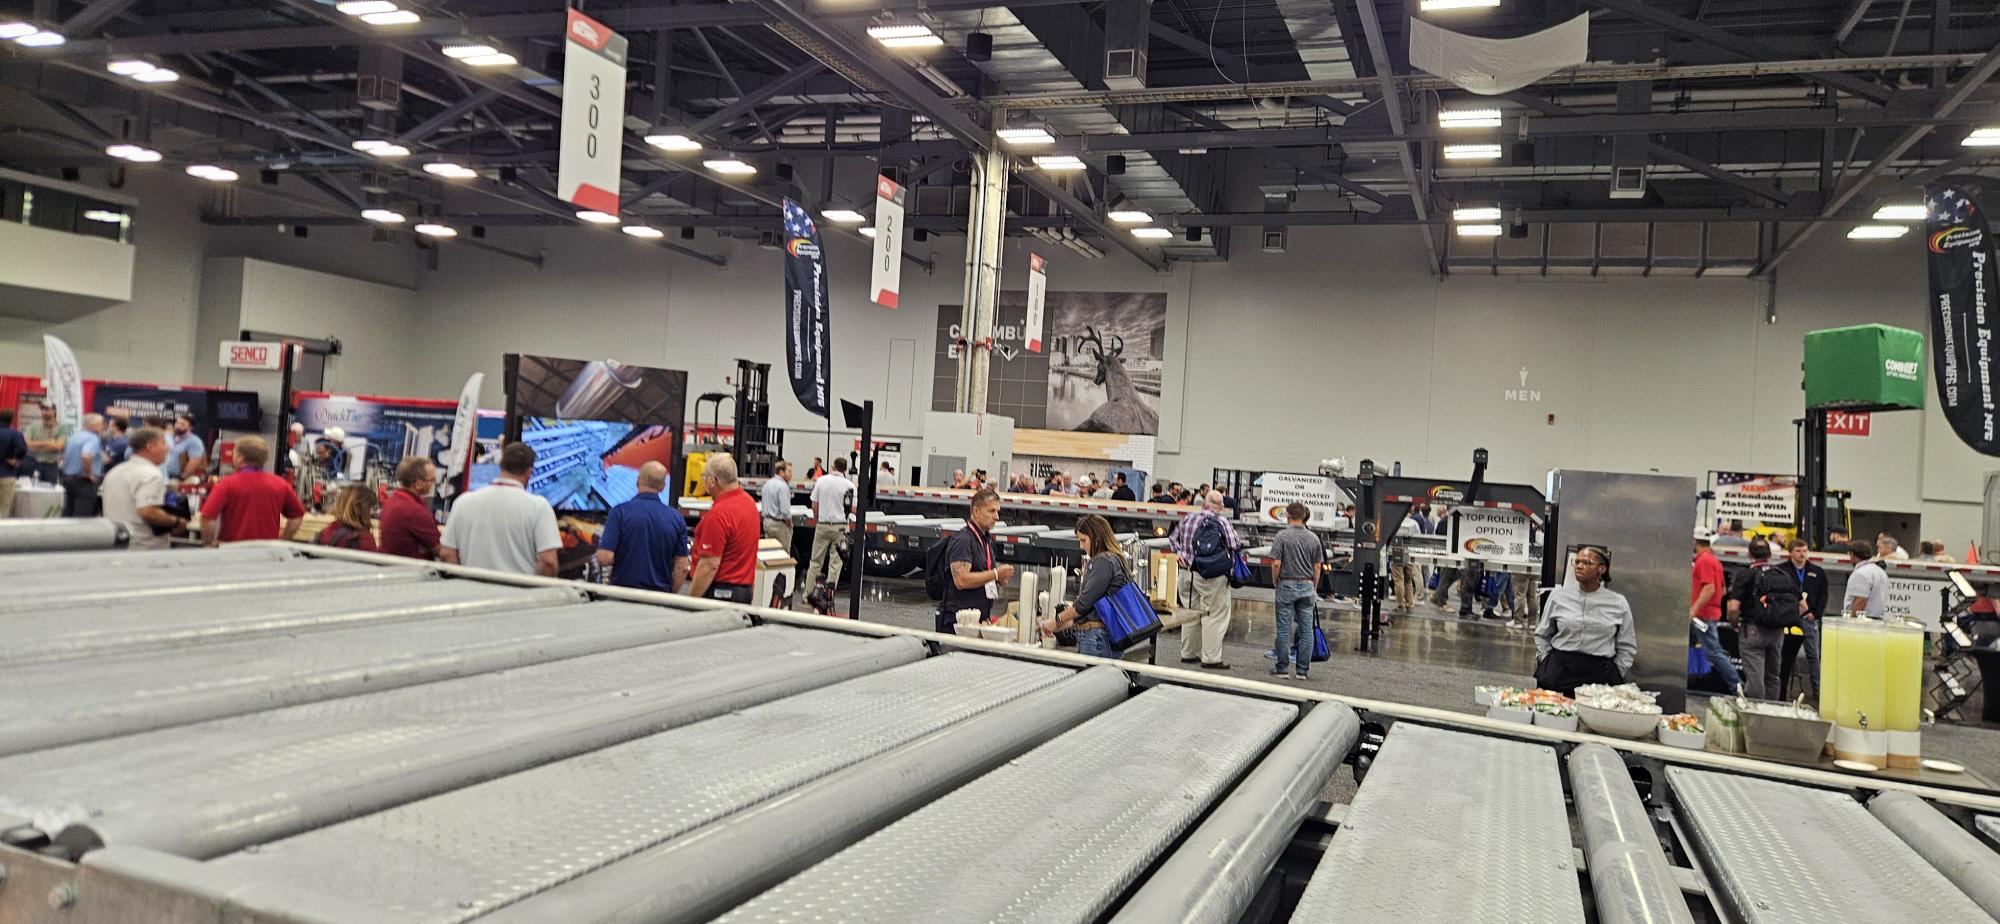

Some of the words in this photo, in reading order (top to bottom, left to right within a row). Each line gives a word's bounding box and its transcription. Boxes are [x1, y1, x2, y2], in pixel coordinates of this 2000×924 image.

[586, 74, 600, 158] 300
[884, 215, 893, 272] 200
[1972, 251, 1987, 325] Precision
[231, 346, 267, 361] SENCO
[1977, 327, 1995, 410] Equipment
[1505, 390, 1541, 401] MEN
[1278, 476, 1323, 484] GALVANIZED
[1725, 492, 1784, 501] Extendable
[1299, 499, 1334, 507] TANDARD
[1466, 513, 1485, 521] TOP
[1487, 514, 1525, 525] ROLLER
[1716, 509, 1755, 517] Forklift
[1758, 511, 1792, 520] Mount
[1475, 527, 1513, 536] OPTION
[1890, 582, 1931, 592] TENTED
[1889, 594, 1911, 602] RAP
[1884, 606, 1911, 614] OCKS
